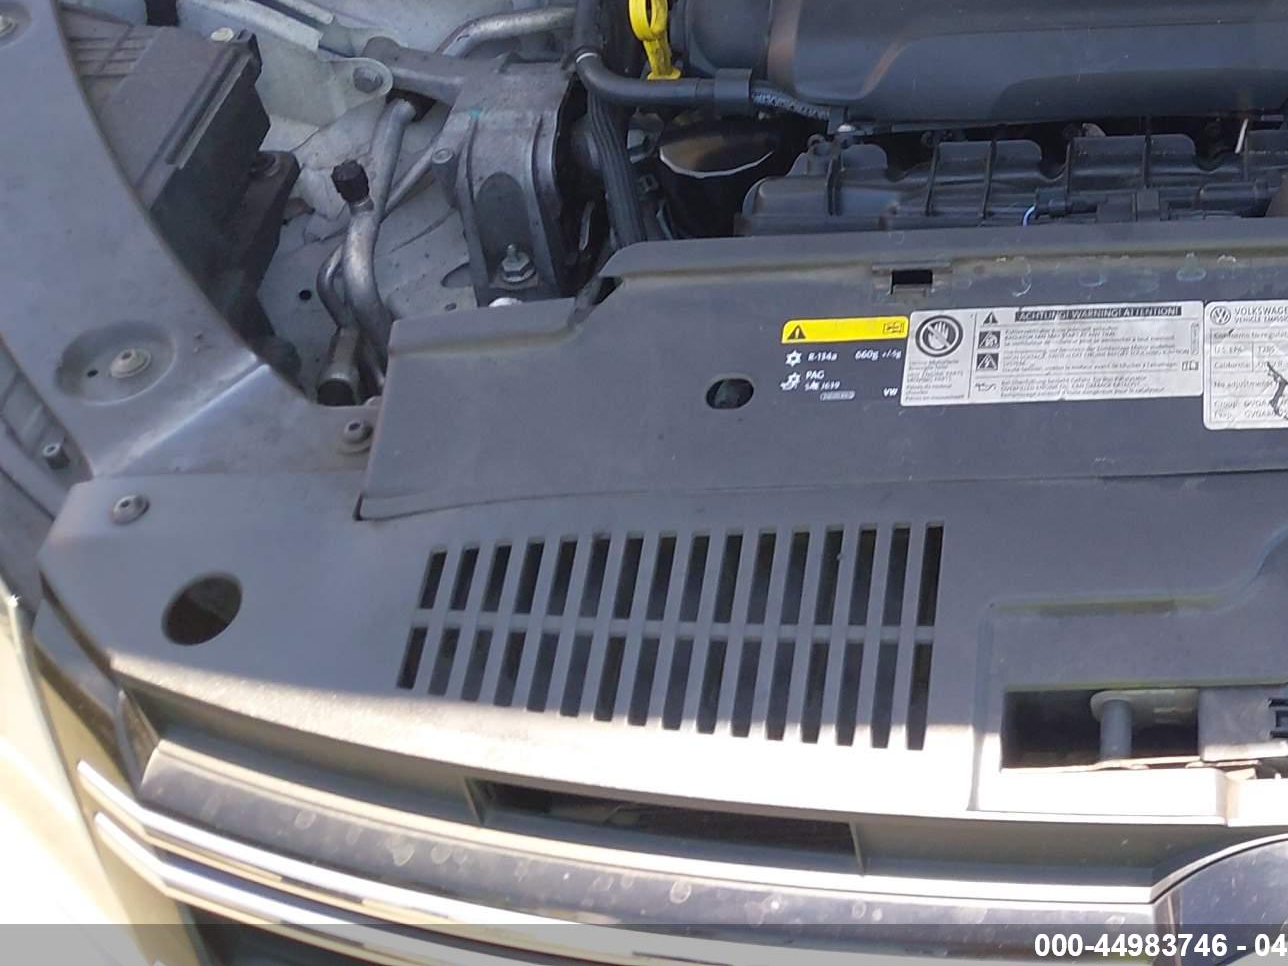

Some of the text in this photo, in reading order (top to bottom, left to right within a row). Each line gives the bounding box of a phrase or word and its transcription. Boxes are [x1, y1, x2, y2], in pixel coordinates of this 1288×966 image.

[1072, 308, 1122, 320] WARNING!
[1123, 305, 1179, 317] ATTENTION!
[855, 348, 879, 361] 660g
[805, 369, 825, 380] PAG
